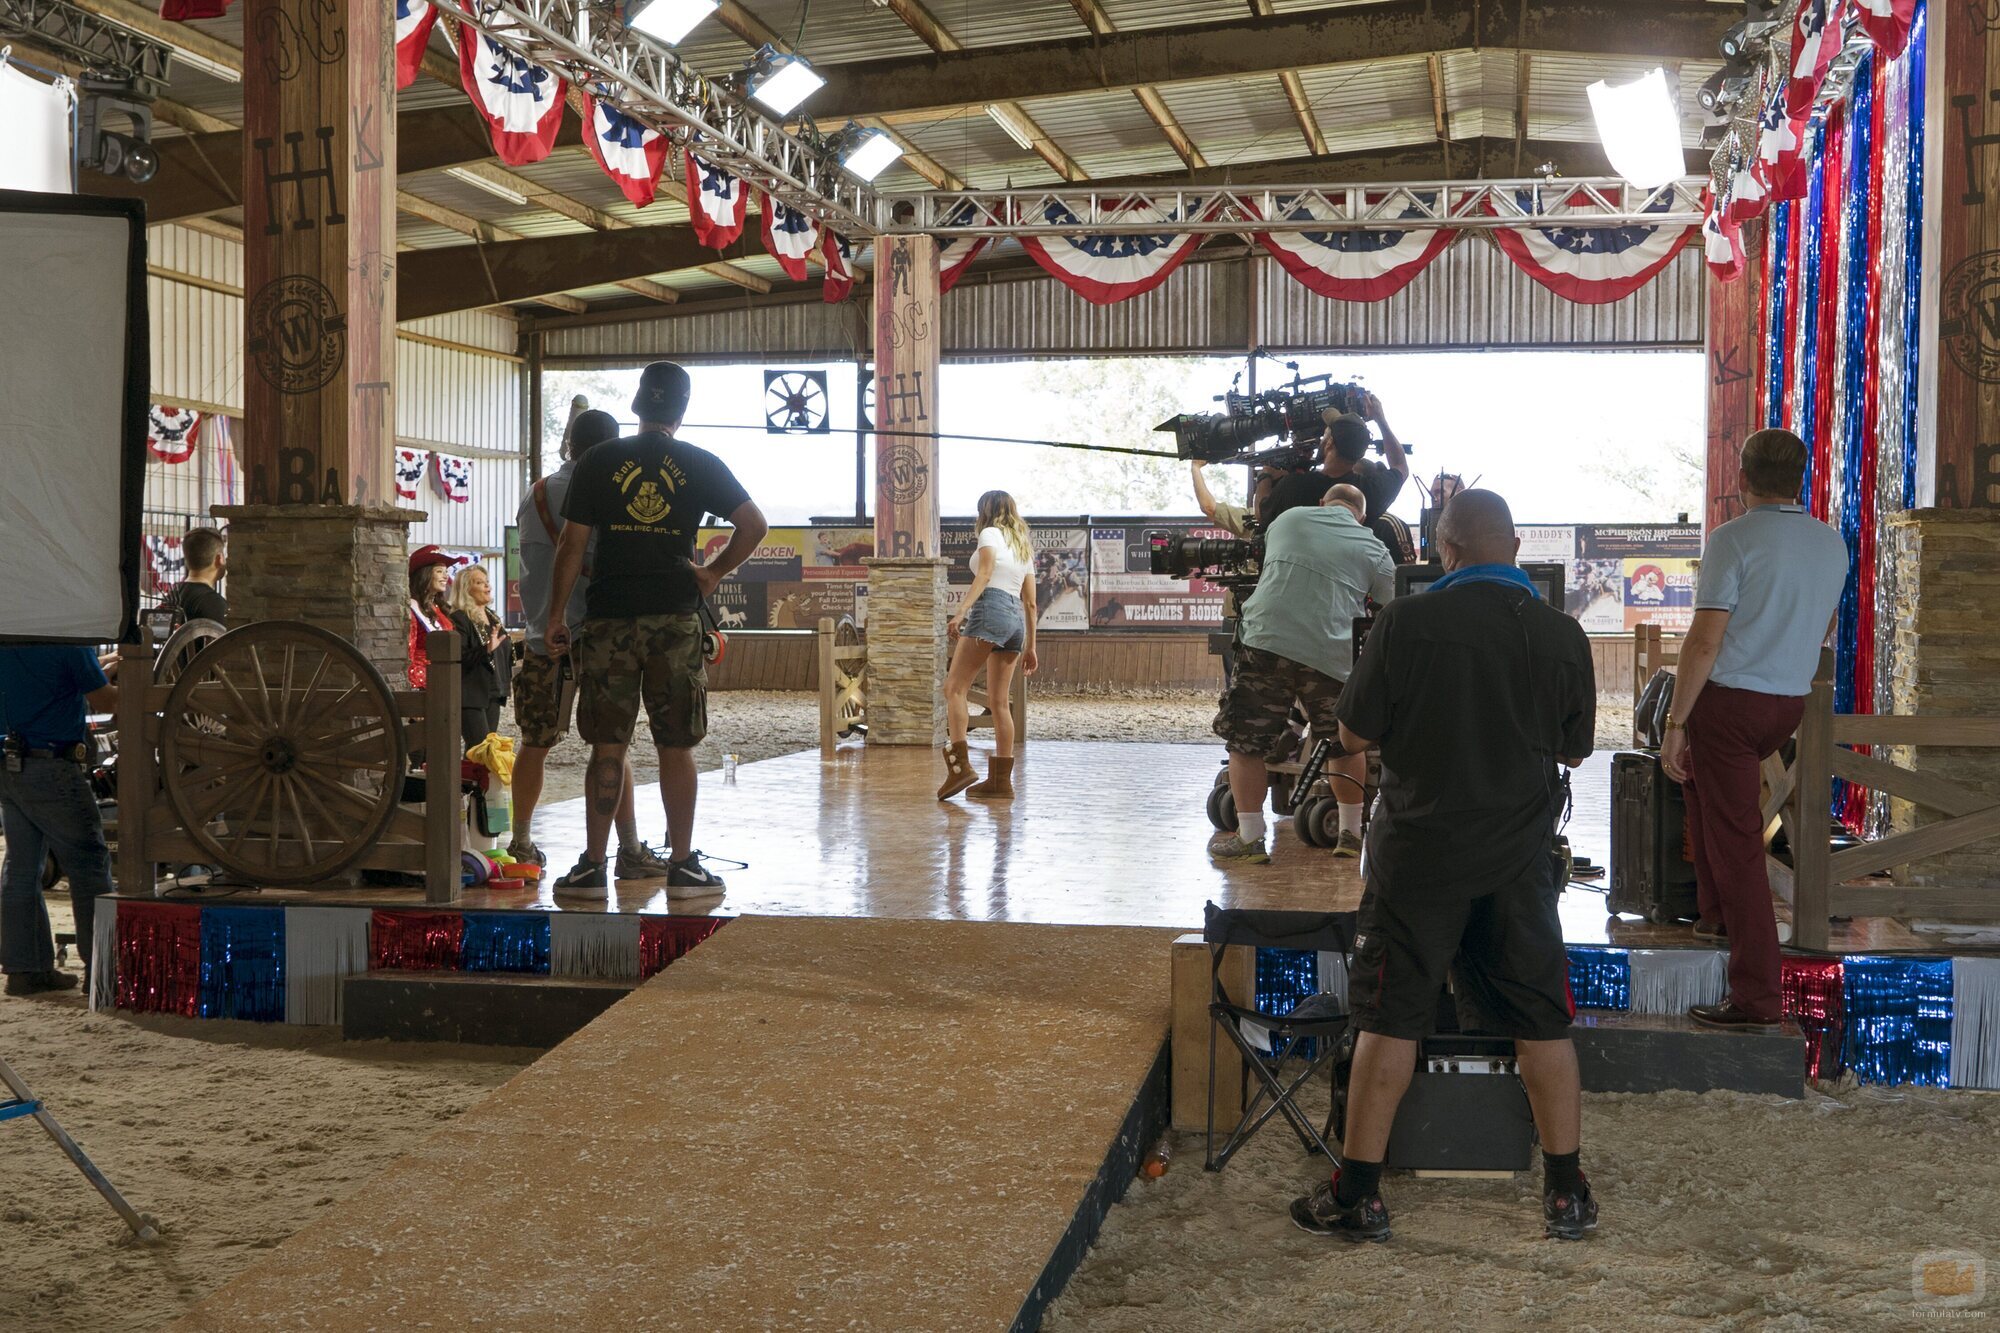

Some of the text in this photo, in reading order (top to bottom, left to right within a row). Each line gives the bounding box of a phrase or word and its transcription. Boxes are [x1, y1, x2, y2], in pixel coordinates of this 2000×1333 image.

[1530, 529, 1572, 539] DADDY'S
[1031, 540, 1068, 548] UNION
[1666, 575, 1692, 585] CHIC
[719, 583, 742, 593] HORSE
[713, 594, 748, 605] TRAINING
[1124, 605, 1183, 620] WELCOMES
